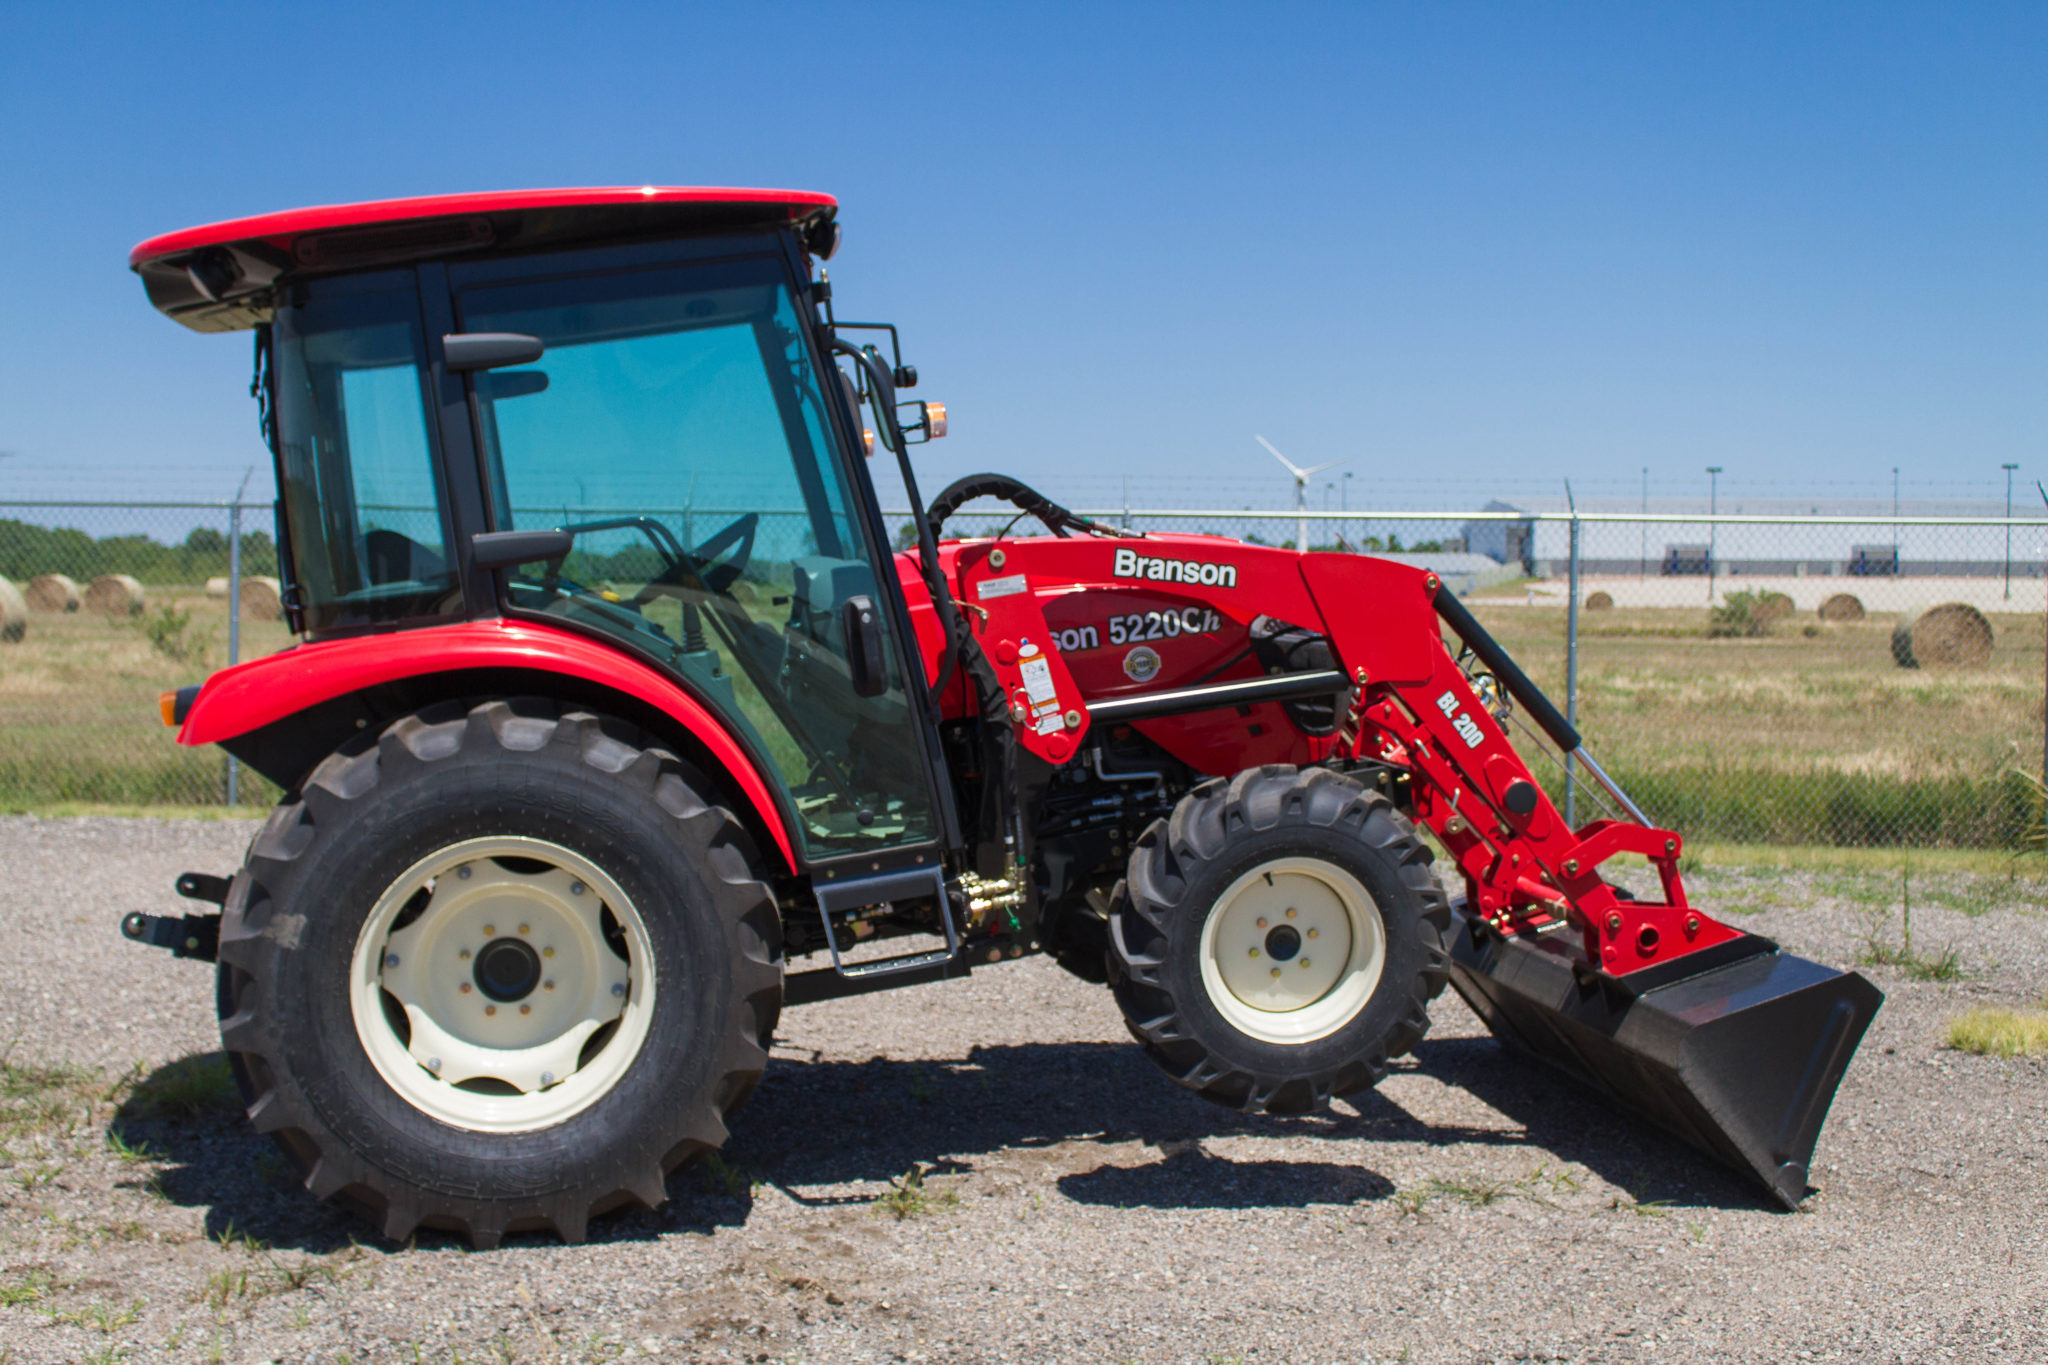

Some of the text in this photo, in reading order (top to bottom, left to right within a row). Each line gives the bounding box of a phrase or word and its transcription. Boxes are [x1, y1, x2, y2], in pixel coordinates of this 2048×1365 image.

[1113, 548, 1237, 588] Branson
[1436, 689, 1485, 749] BL 200
